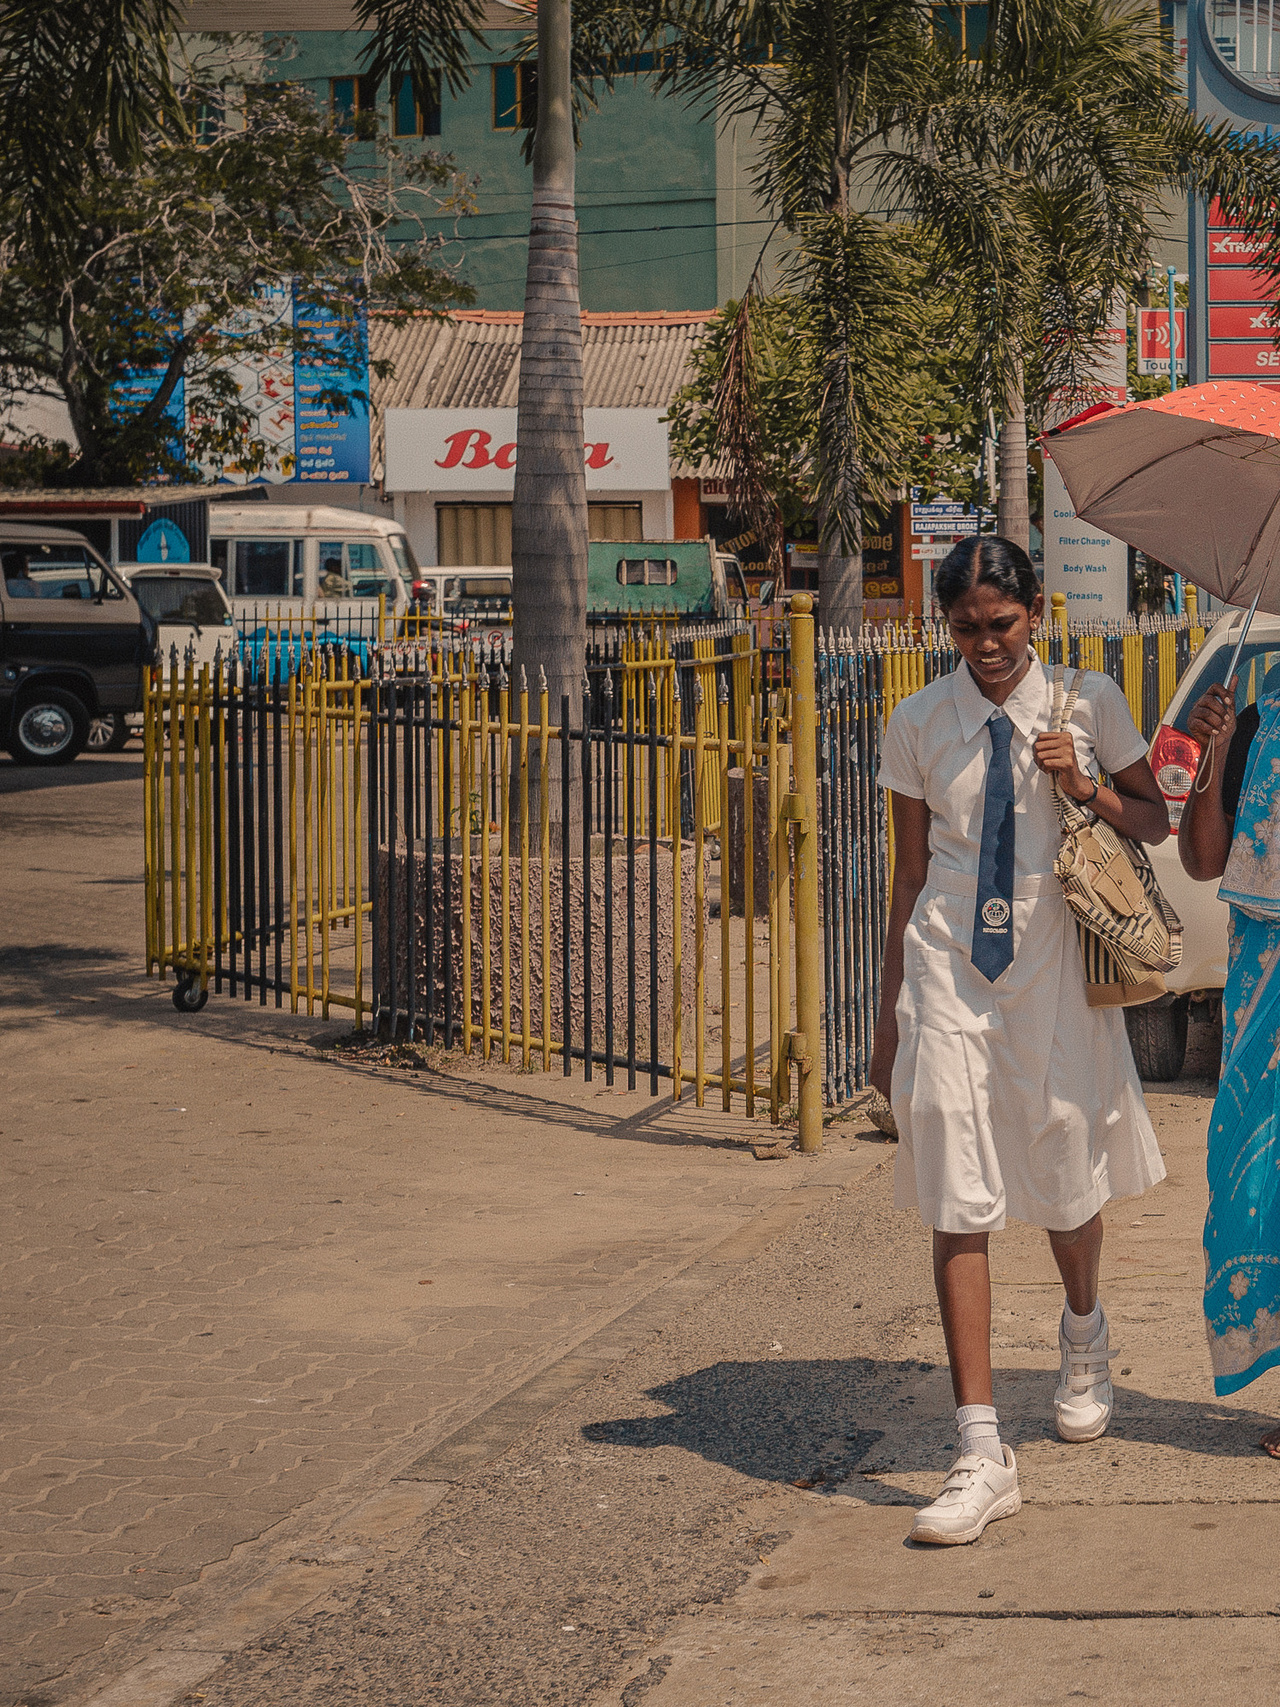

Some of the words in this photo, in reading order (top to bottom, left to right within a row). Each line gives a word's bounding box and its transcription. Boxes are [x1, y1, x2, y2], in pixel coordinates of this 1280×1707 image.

[434, 429, 614, 469] Baa
[1059, 537, 1079, 545] Filter
[1081, 537, 1111, 547] Change
[1063, 564, 1083, 573] Body
[1085, 564, 1107, 572] Wash
[1066, 591, 1103, 601] Greasing
